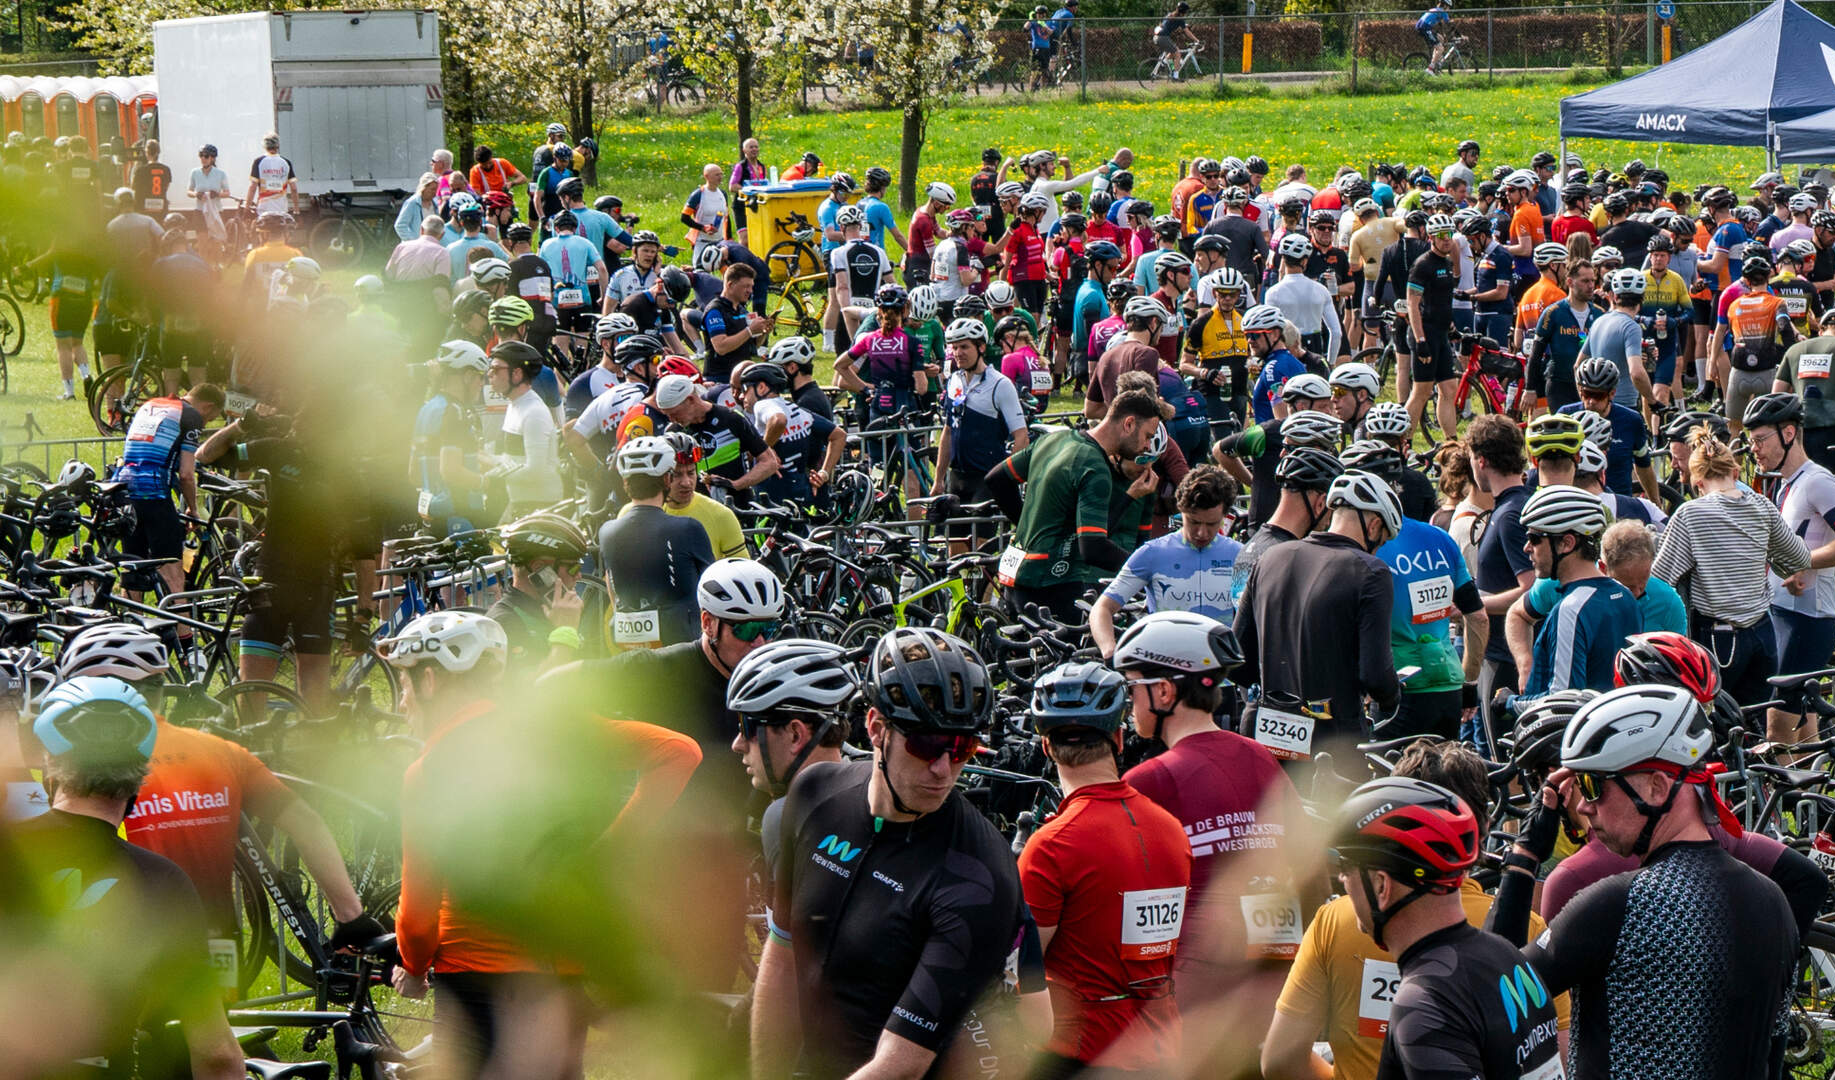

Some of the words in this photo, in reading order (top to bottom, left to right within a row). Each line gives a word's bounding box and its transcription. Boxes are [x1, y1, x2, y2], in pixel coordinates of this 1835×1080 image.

[1636, 114, 1688, 132] AMACX
[1802, 359, 1828, 367] 39622
[1387, 549, 1451, 577] OKIA
[1417, 587, 1448, 604] 31122
[1132, 647, 1194, 669] S-WORKS
[1259, 717, 1308, 741] 32340
[175, 787, 229, 813] Vitaal
[1196, 819, 1213, 833] DE
[1216, 811, 1256, 828] BRAUW
[1217, 836, 1278, 853] WESTBROEK
[811, 853, 851, 879] newnexus
[239, 836, 306, 940] FONDRIEST
[872, 871, 898, 888] CRAFT
[1136, 903, 1179, 927] 31126
